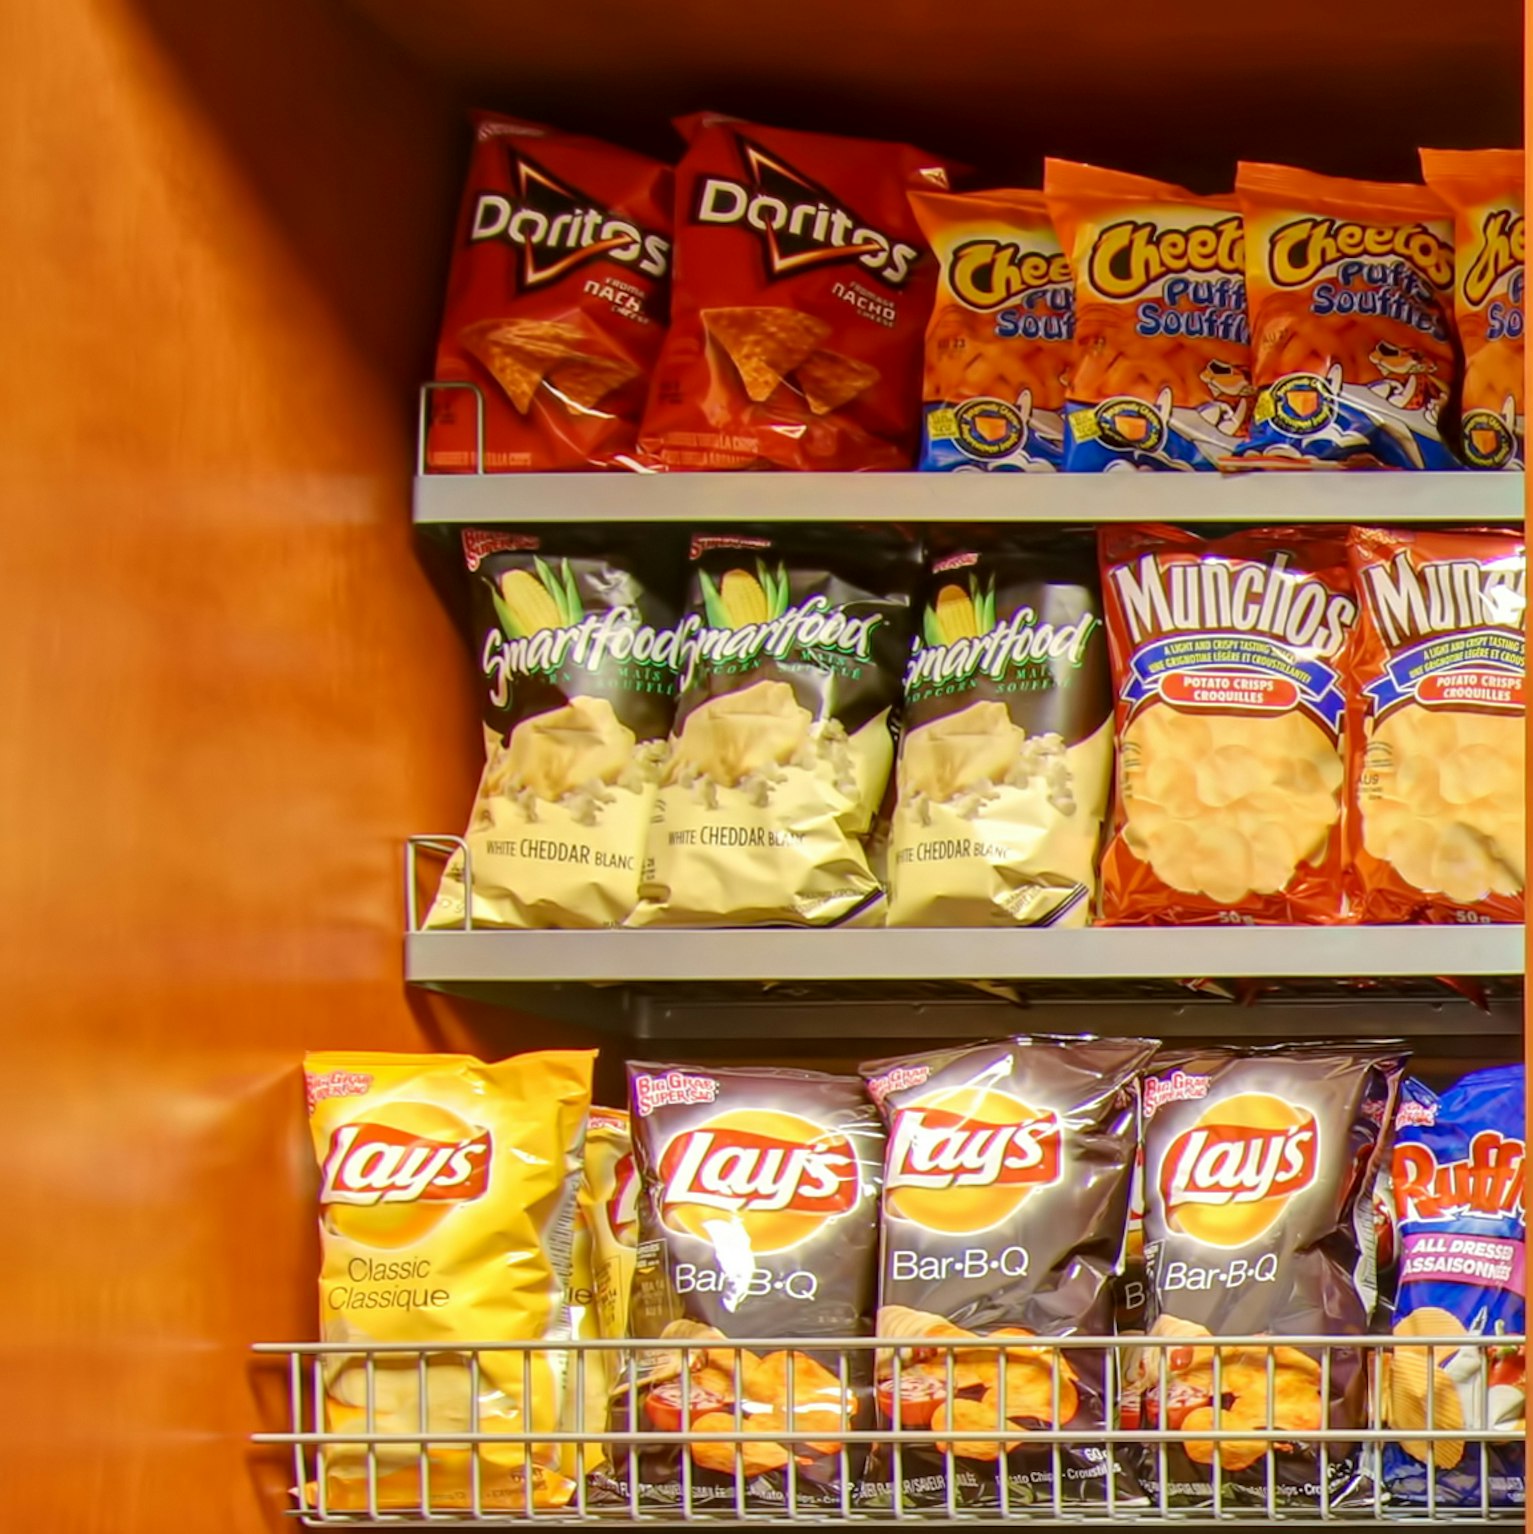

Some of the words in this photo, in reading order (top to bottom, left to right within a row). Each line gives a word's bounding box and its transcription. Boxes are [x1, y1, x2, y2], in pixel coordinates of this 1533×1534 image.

[471, 195, 671, 278] Doritos
[699, 177, 918, 283] Doritos
[1270, 217, 1455, 290] Cheetos
[949, 240, 1073, 312] Chee
[1109, 551, 1358, 660] Munchos
[482, 606, 684, 709] Smartfood
[1213, 640, 1239, 651] CRISPY
[1240, 641, 1272, 654] TASTING
[1184, 676, 1230, 690] POTATO
[1233, 677, 1275, 692] CRISPS
[1194, 690, 1264, 704] CROQUILLES
[1437, 675, 1477, 689] POTATO
[1481, 676, 1522, 690] CRISPS
[1444, 687, 1512, 702] CROQUILLES
[668, 828, 697, 846] WHITE
[700, 825, 766, 848] CHEDDAR
[916, 840, 971, 862] CHEDDAR
[486, 840, 517, 857] WHITE
[519, 838, 590, 864] CHEDDAR
[594, 853, 635, 871] BLANC
[321, 1126, 486, 1204] Lay's
[888, 1110, 1056, 1188] Lay's
[1165, 1122, 1316, 1204] Lay's
[663, 1131, 851, 1212] Lay's
[1412, 1239, 1446, 1254] ALL
[348, 1256, 432, 1283] Classic
[327, 1284, 450, 1313] Classique
